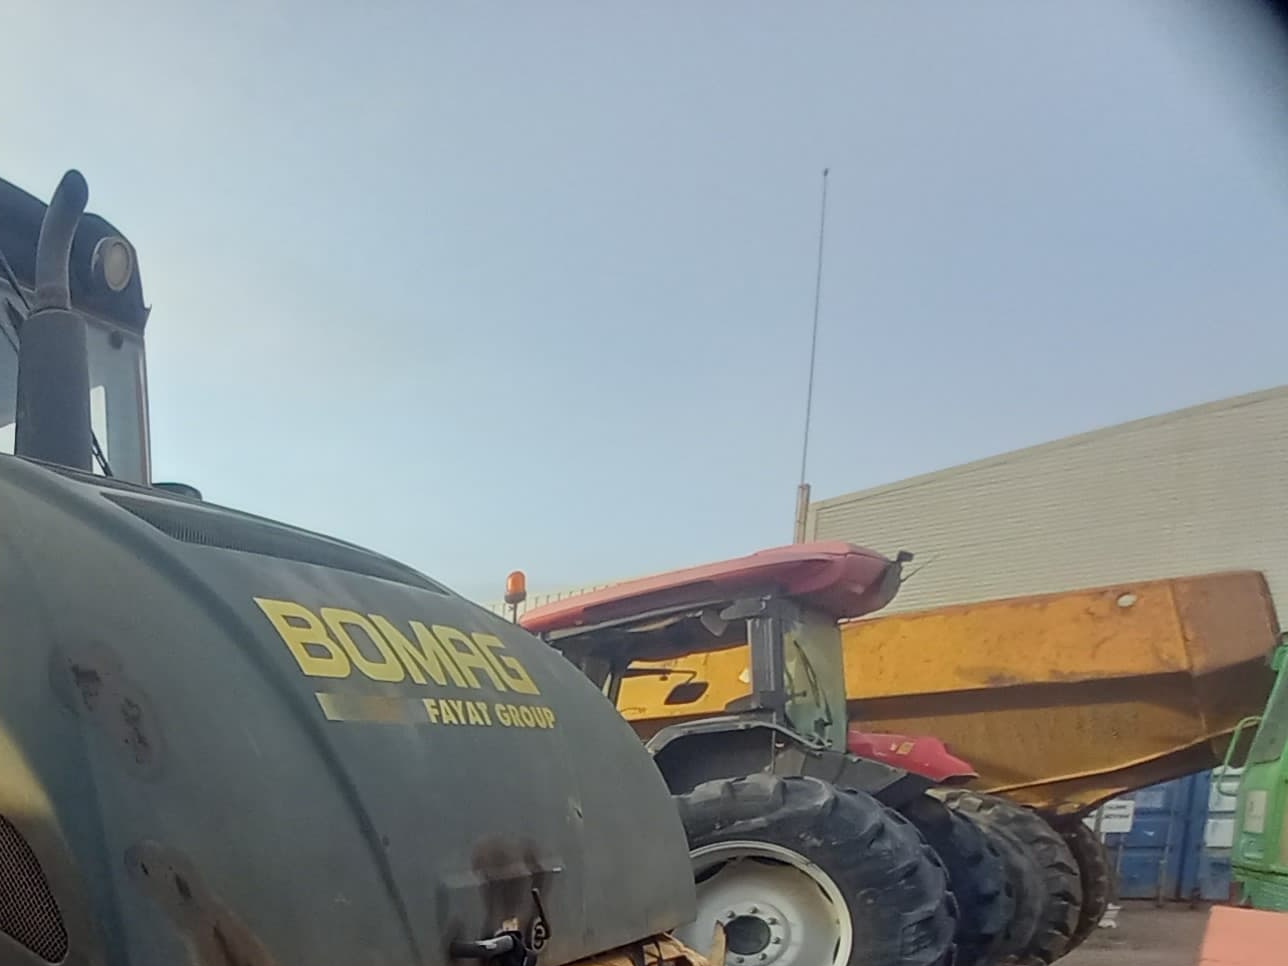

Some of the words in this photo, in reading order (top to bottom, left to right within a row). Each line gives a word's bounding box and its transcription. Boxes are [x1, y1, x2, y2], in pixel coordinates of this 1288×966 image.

[253, 597, 540, 695] BOMAG
[422, 698, 493, 726] FAYAT
[495, 703, 555, 729] GROUP
